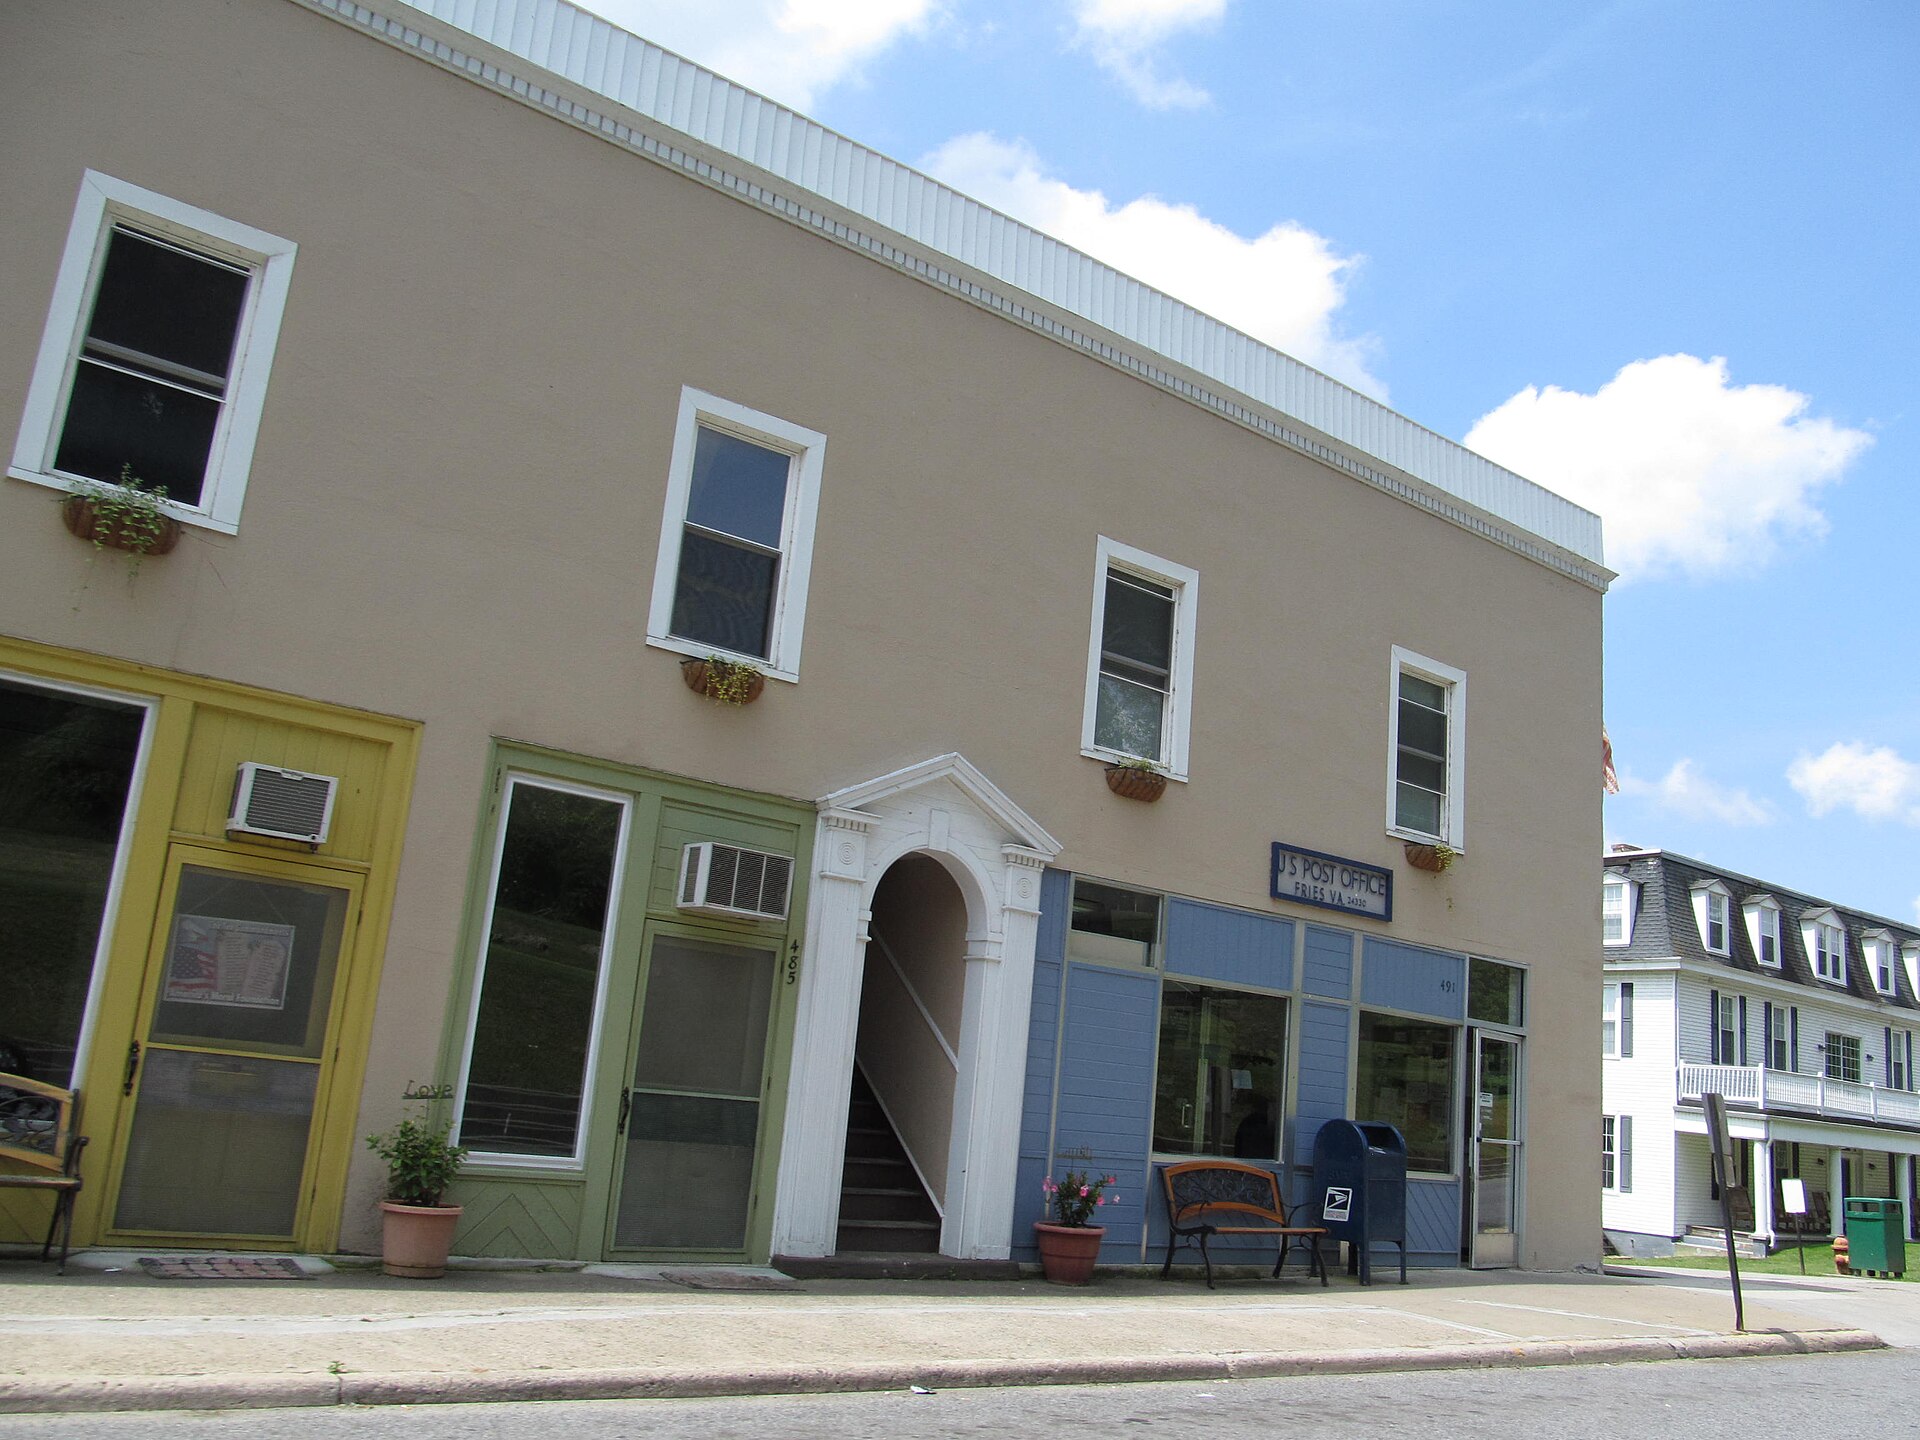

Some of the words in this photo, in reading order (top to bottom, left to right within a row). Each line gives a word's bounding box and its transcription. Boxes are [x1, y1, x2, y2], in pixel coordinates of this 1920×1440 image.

[1289, 855, 1298, 876] S
[1303, 859, 1336, 885] POST
[1340, 868, 1385, 897] OFFICE
[1295, 881, 1324, 901] FRIES
[787, 939, 799, 984] 485
[1440, 980, 1455, 992] 491
[403, 1079, 453, 1099] Love
